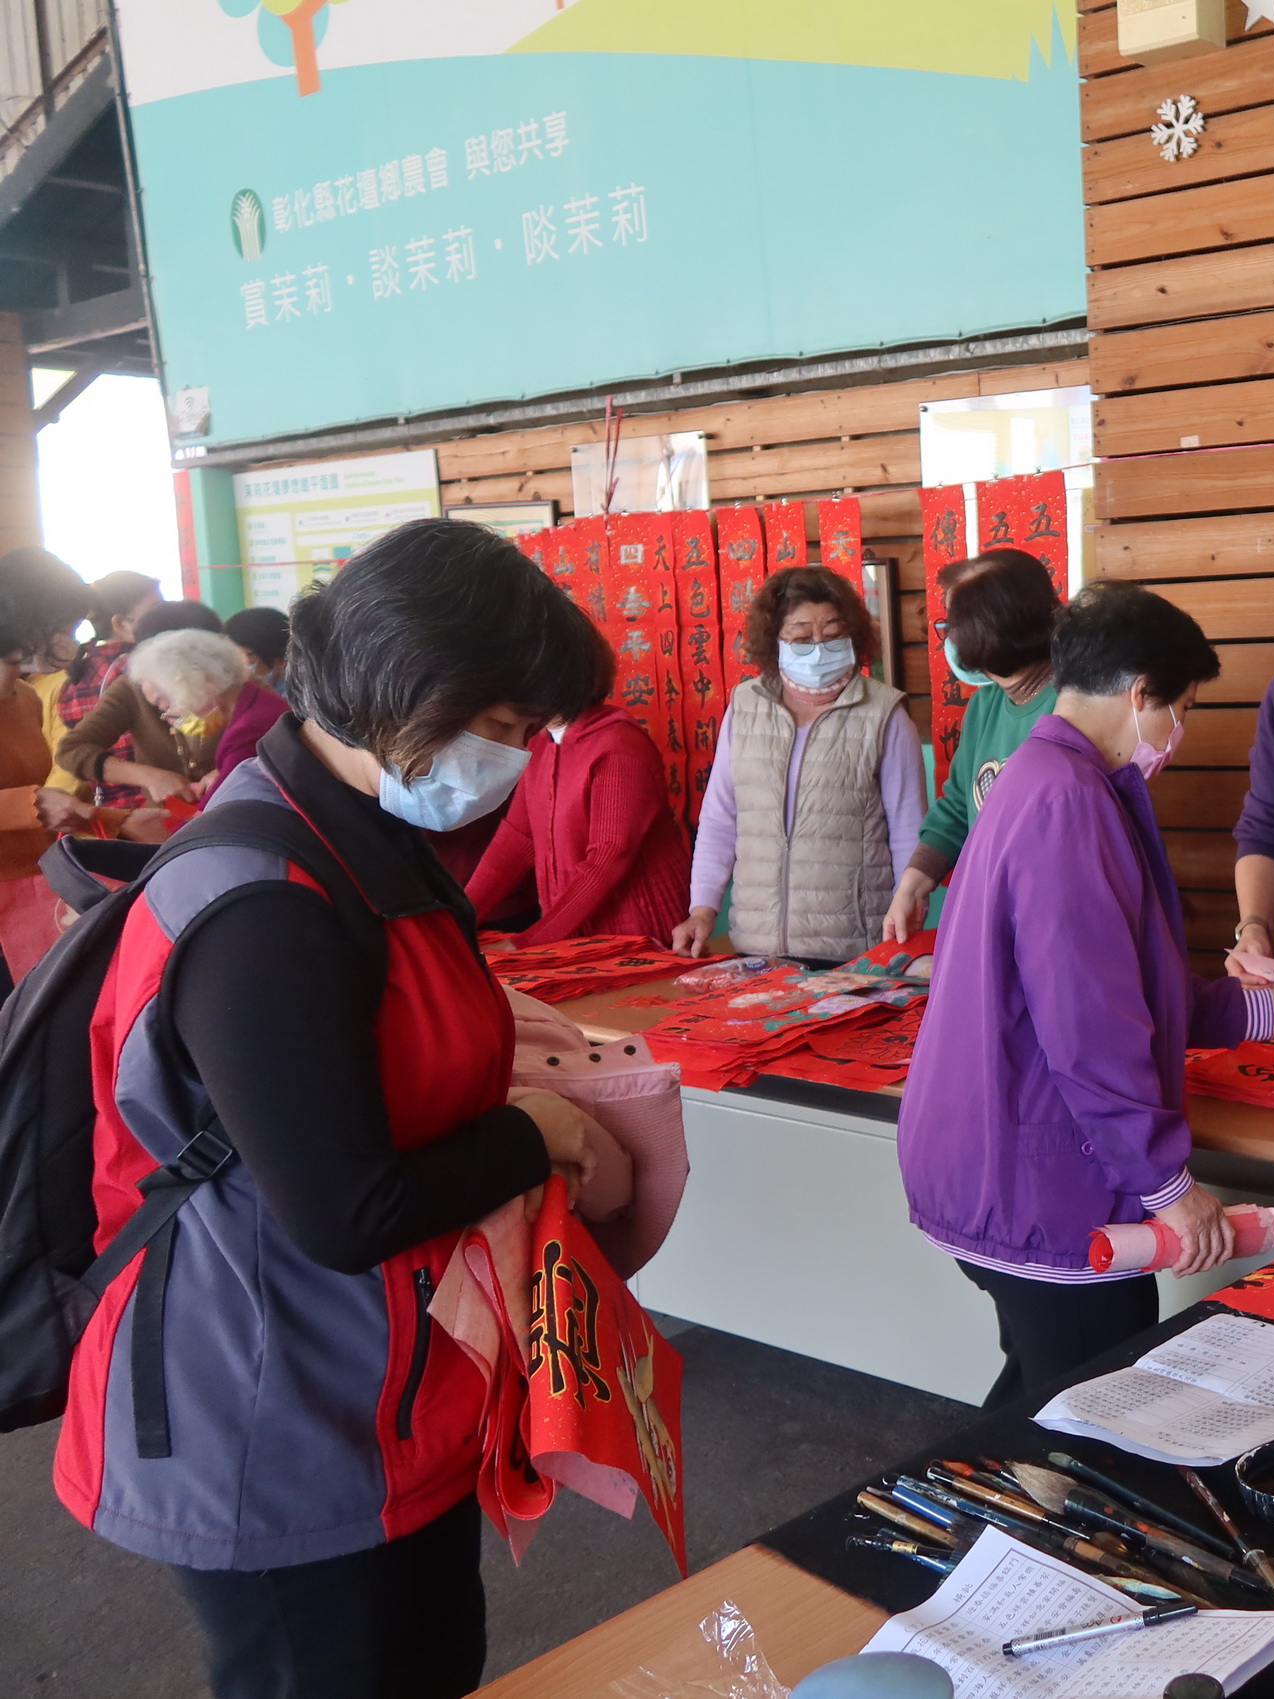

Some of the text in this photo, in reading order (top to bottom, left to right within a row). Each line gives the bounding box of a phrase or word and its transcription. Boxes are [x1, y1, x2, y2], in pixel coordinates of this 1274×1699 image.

[272, 111, 570, 233] 彰化縣花壇鄉農會 與您共享
